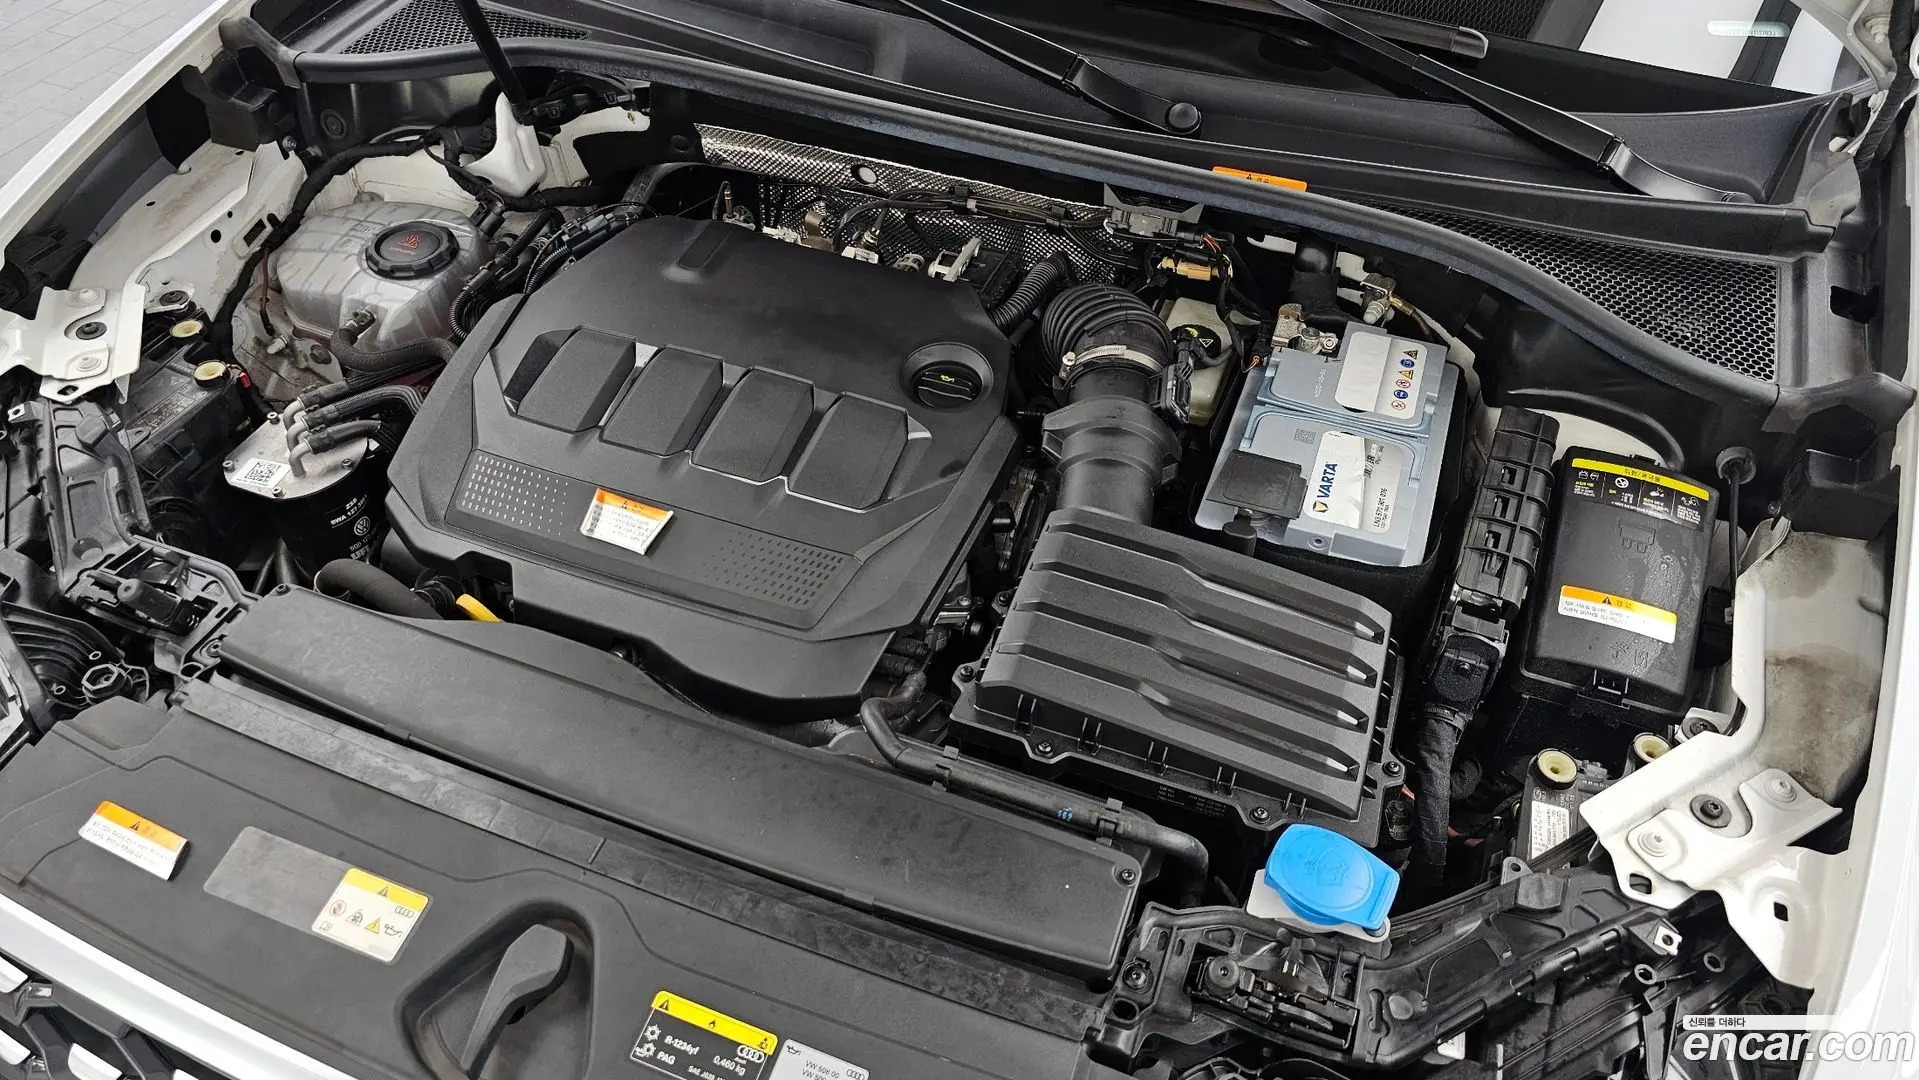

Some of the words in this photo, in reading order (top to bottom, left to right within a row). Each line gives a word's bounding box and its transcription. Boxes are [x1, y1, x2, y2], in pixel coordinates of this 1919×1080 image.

[1316, 461, 1338, 499] VARTA
[664, 1035, 700, 1056] R-1234yf
[656, 1050, 676, 1066] PAG
[712, 1055, 736, 1070] 0,460
[736, 1064, 746, 1076] kg
[806, 1060, 818, 1070] VW
[688, 1066, 701, 1076] SAE
[802, 1068, 814, 1078] VW
